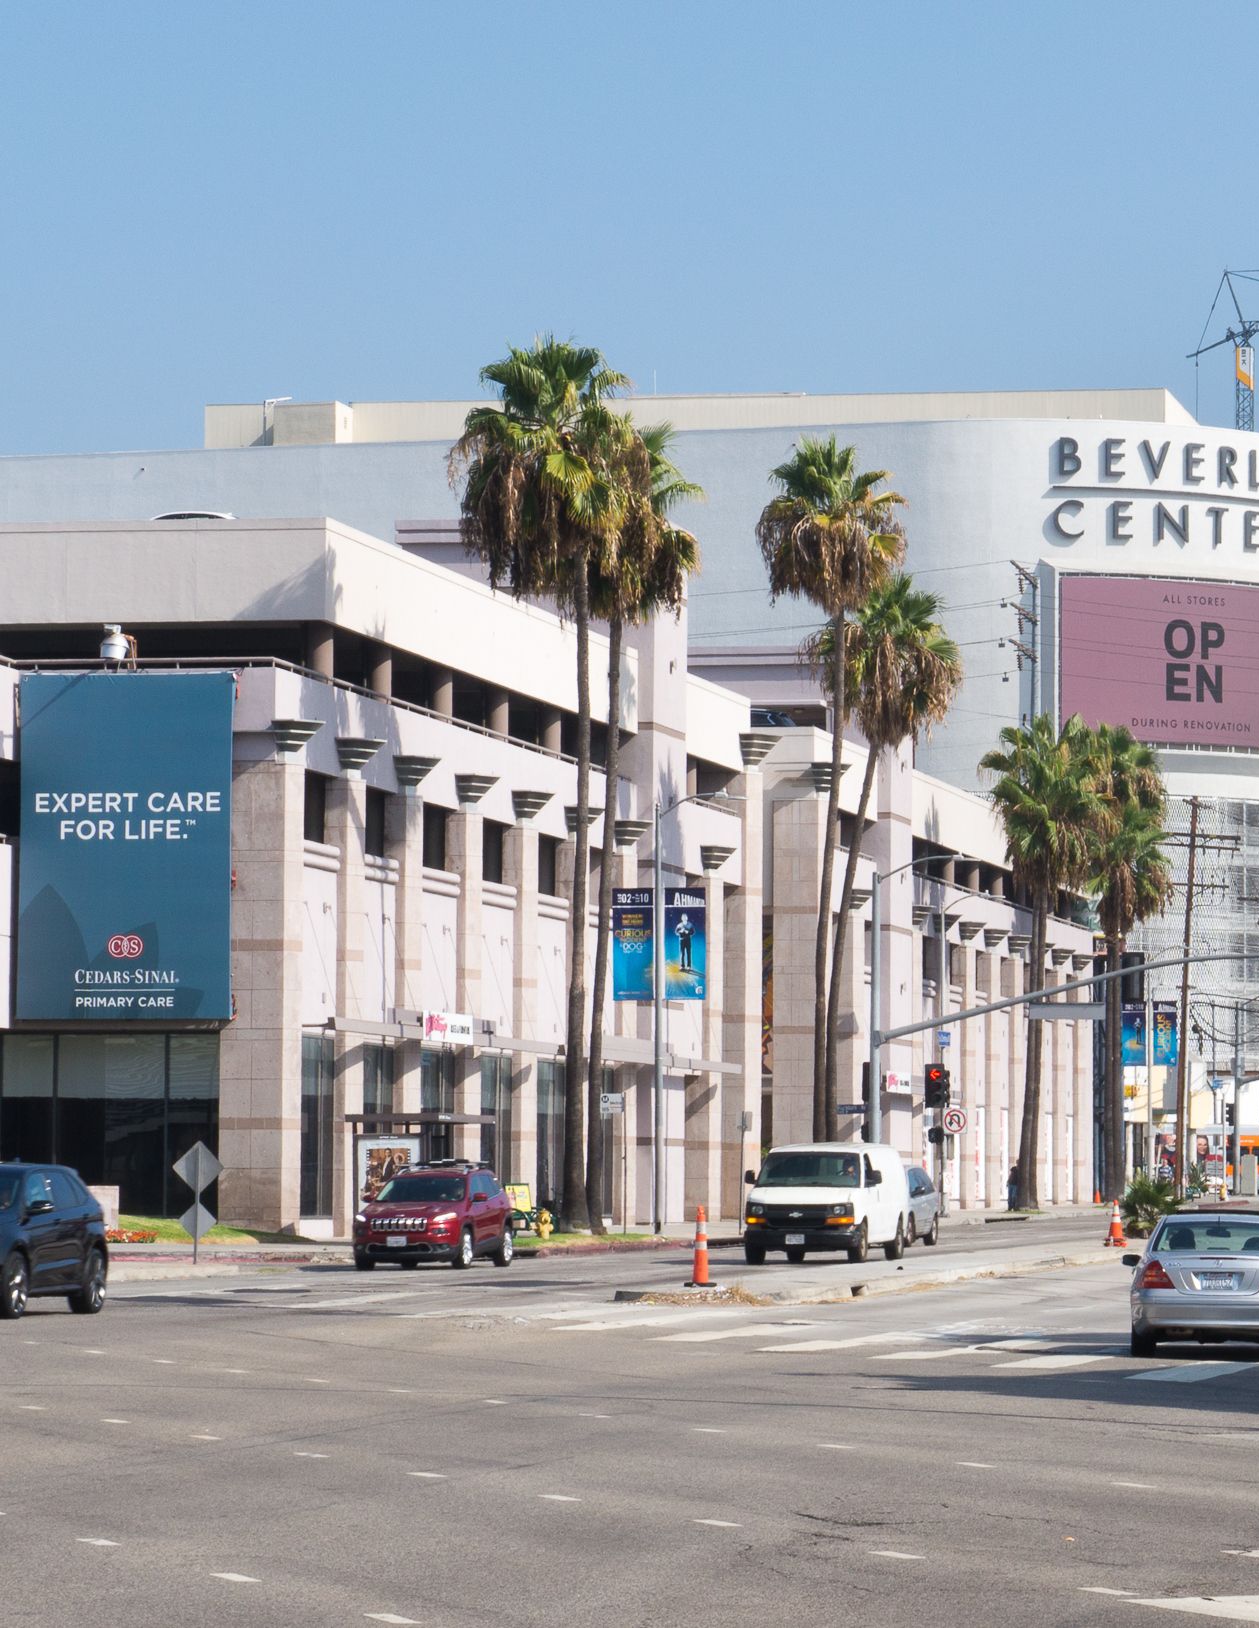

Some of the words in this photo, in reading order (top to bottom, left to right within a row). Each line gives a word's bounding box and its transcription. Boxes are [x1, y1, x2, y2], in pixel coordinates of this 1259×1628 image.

[1162, 594, 1181, 605] ALL
[1186, 595, 1226, 607] STORES
[1163, 618, 1225, 660] OP
[1165, 662, 1223, 704] EN
[1131, 717, 1178, 728] DURING
[1183, 720, 1251, 732] RENOVATION
[35, 791, 139, 813] EXPERT
[147, 791, 222, 812] CARE
[59, 819, 115, 841] FOR
[75, 996, 135, 1008] PRIMARY
[138, 996, 175, 1007] CARE
